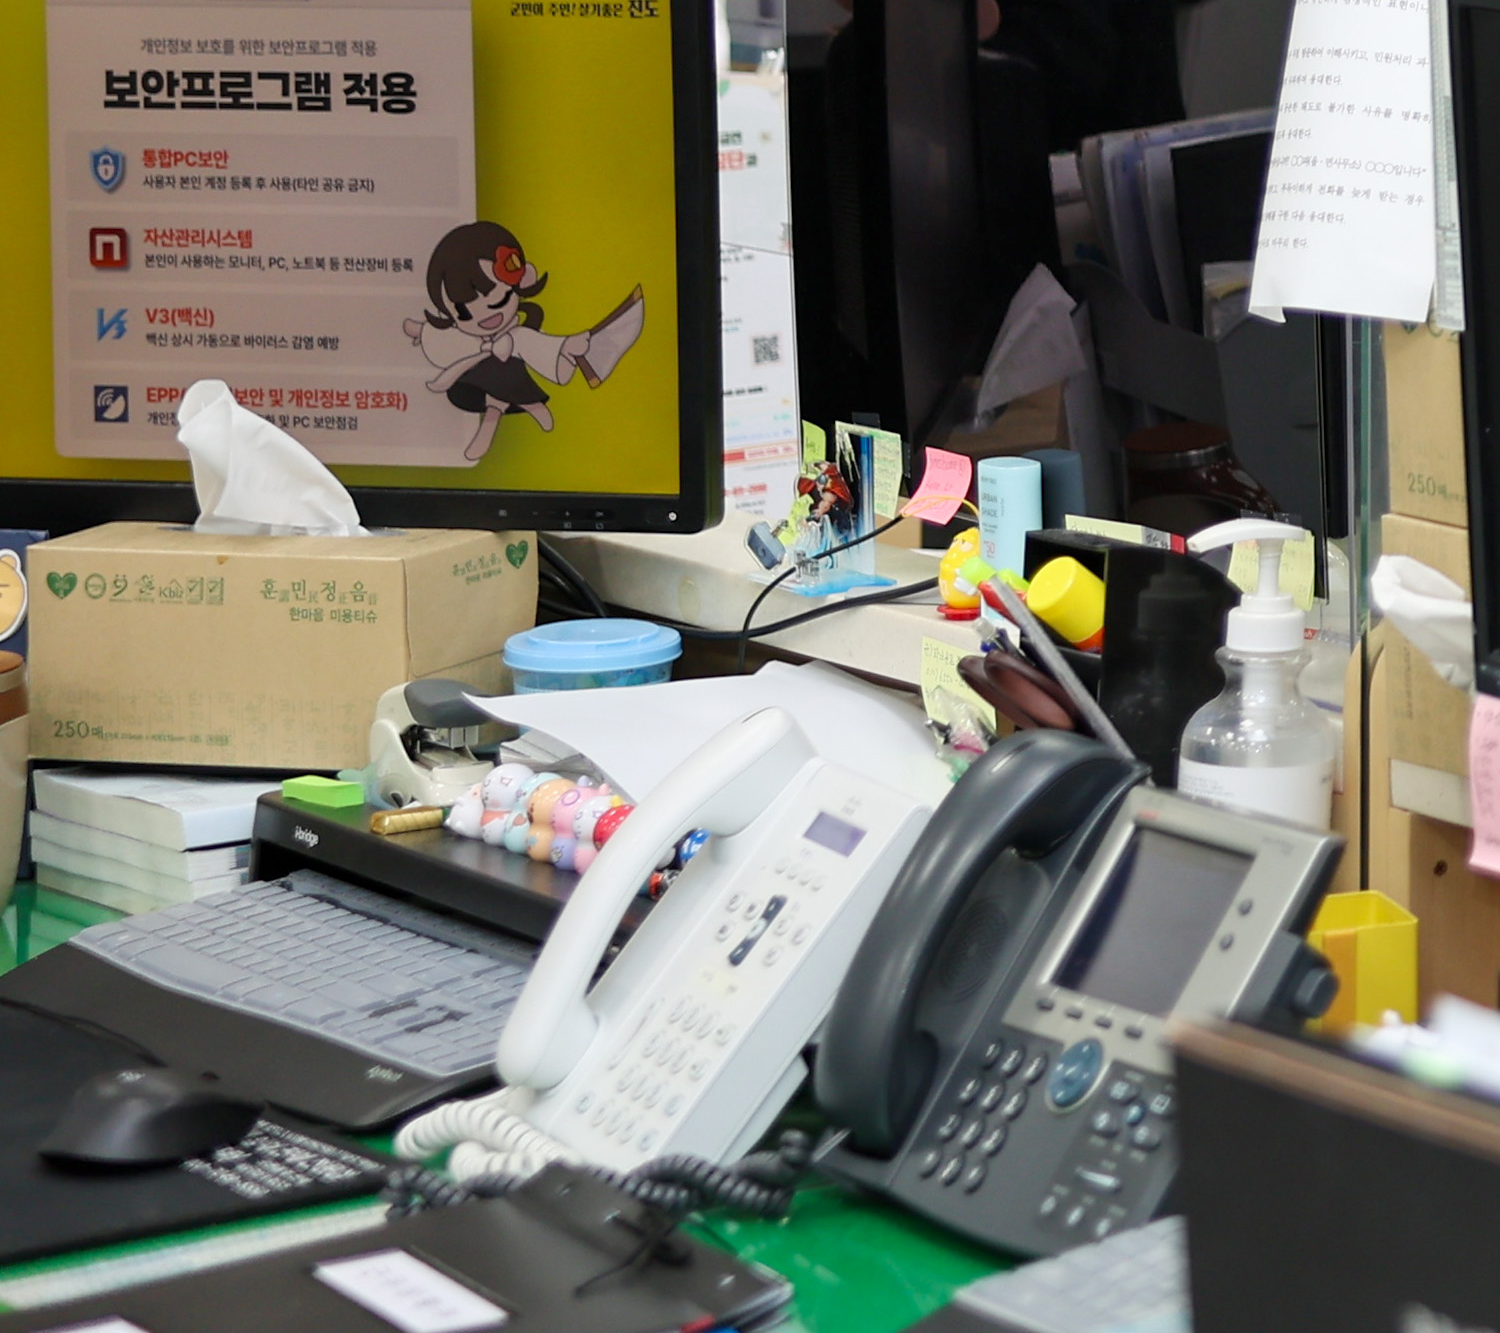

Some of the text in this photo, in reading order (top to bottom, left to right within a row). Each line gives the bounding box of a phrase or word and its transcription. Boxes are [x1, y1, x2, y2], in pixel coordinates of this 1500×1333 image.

[140, 39, 378, 57] 개인정보 보호를 위한 보안프로그램 적용
[103, 69, 418, 116] 보안프로그램 적용
[142, 148, 229, 170] 통합PC보안
[143, 175, 176, 190] 사용자
[179, 175, 202, 190] 본인
[255, 176, 267, 191] 후
[269, 177, 319, 193] 사용(타인
[322, 178, 345, 193] 공유
[347, 178, 375, 194] 금지)
[143, 228, 254, 250] 자산관리시스템
[144, 253, 414, 273] 본인이 사용하는 모니터, PC, 노트북 등 전산장비 등록
[145, 307, 215, 328] V3(백신)
[146, 333, 168, 348] 백신
[171, 334, 194, 348] 상시
[196, 334, 242, 349] 가동으로
[244, 334, 289, 350] 바이러스
[269, 389, 284, 408] 및
[288, 390, 351, 409] 개인정보
[354, 391, 408, 412] 암호화)
[293, 416, 310, 429] PC
[313, 416, 358, 431] 보안점검
[330, 607, 378, 625] 미용티슈
